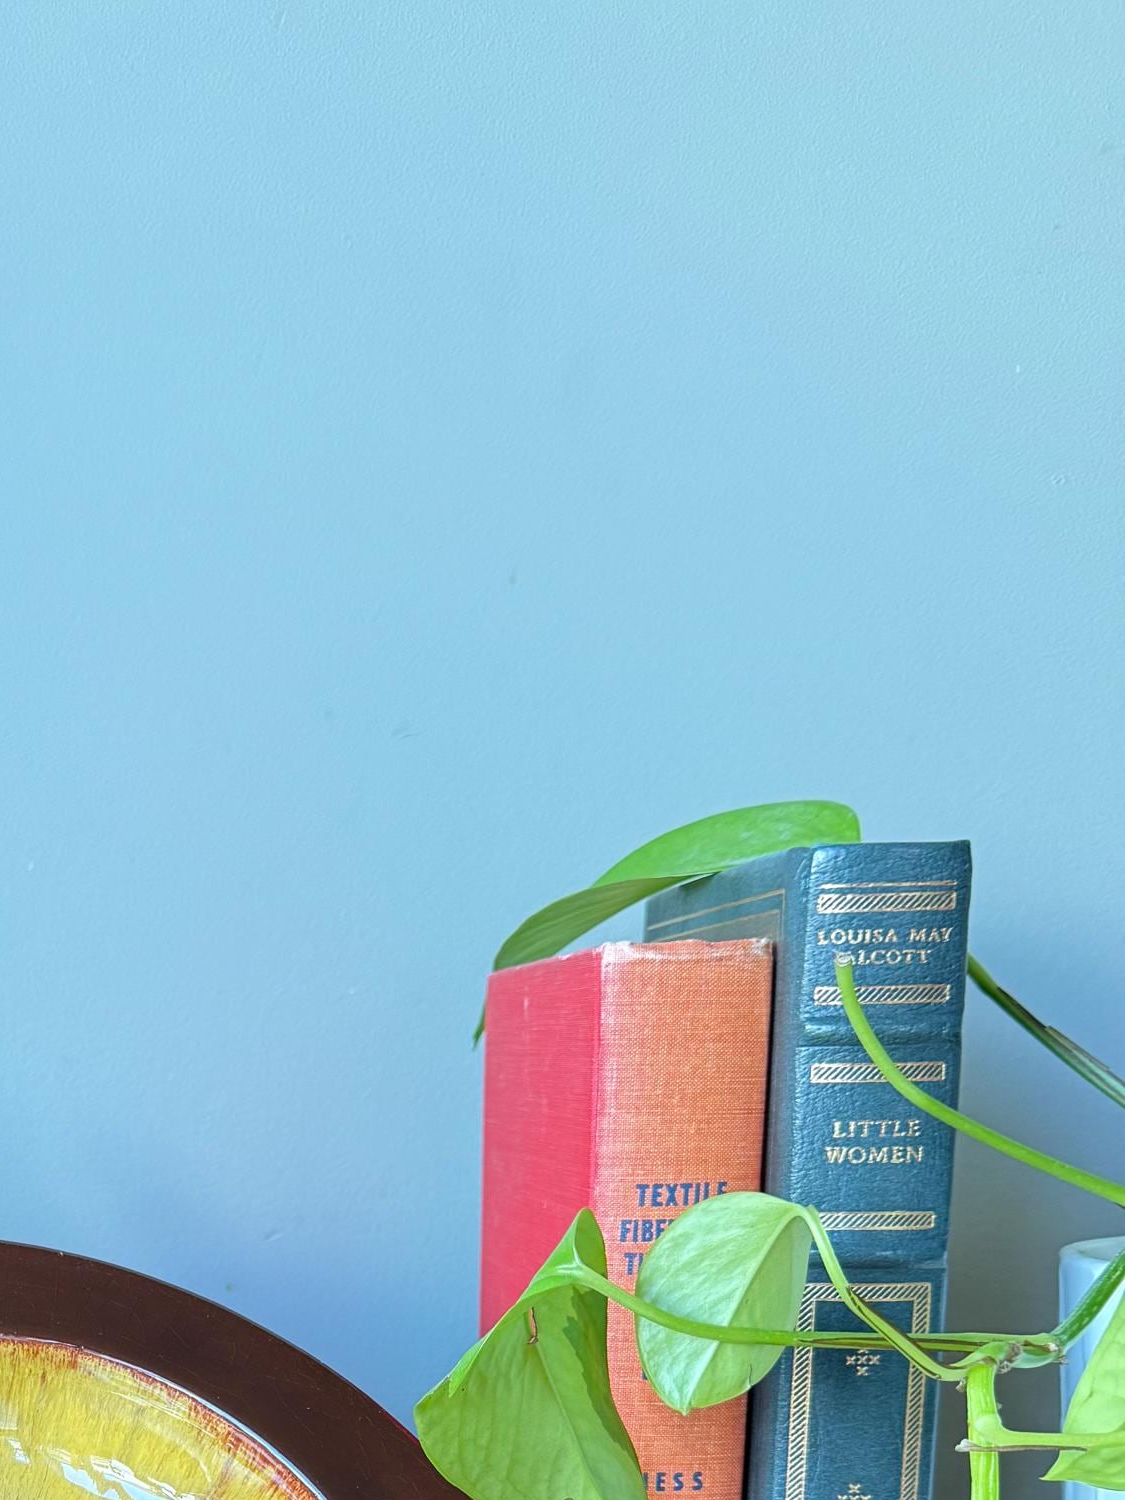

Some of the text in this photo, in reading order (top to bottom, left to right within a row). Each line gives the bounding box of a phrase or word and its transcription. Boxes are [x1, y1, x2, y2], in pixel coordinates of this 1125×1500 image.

[817, 926, 954, 945] LOUISA MAY
[837, 949, 931, 965] LCOTT
[832, 1120, 921, 1138] LITTLE
[825, 1146, 924, 1164] WOMEN
[619, 1218, 675, 1243] FIBE
